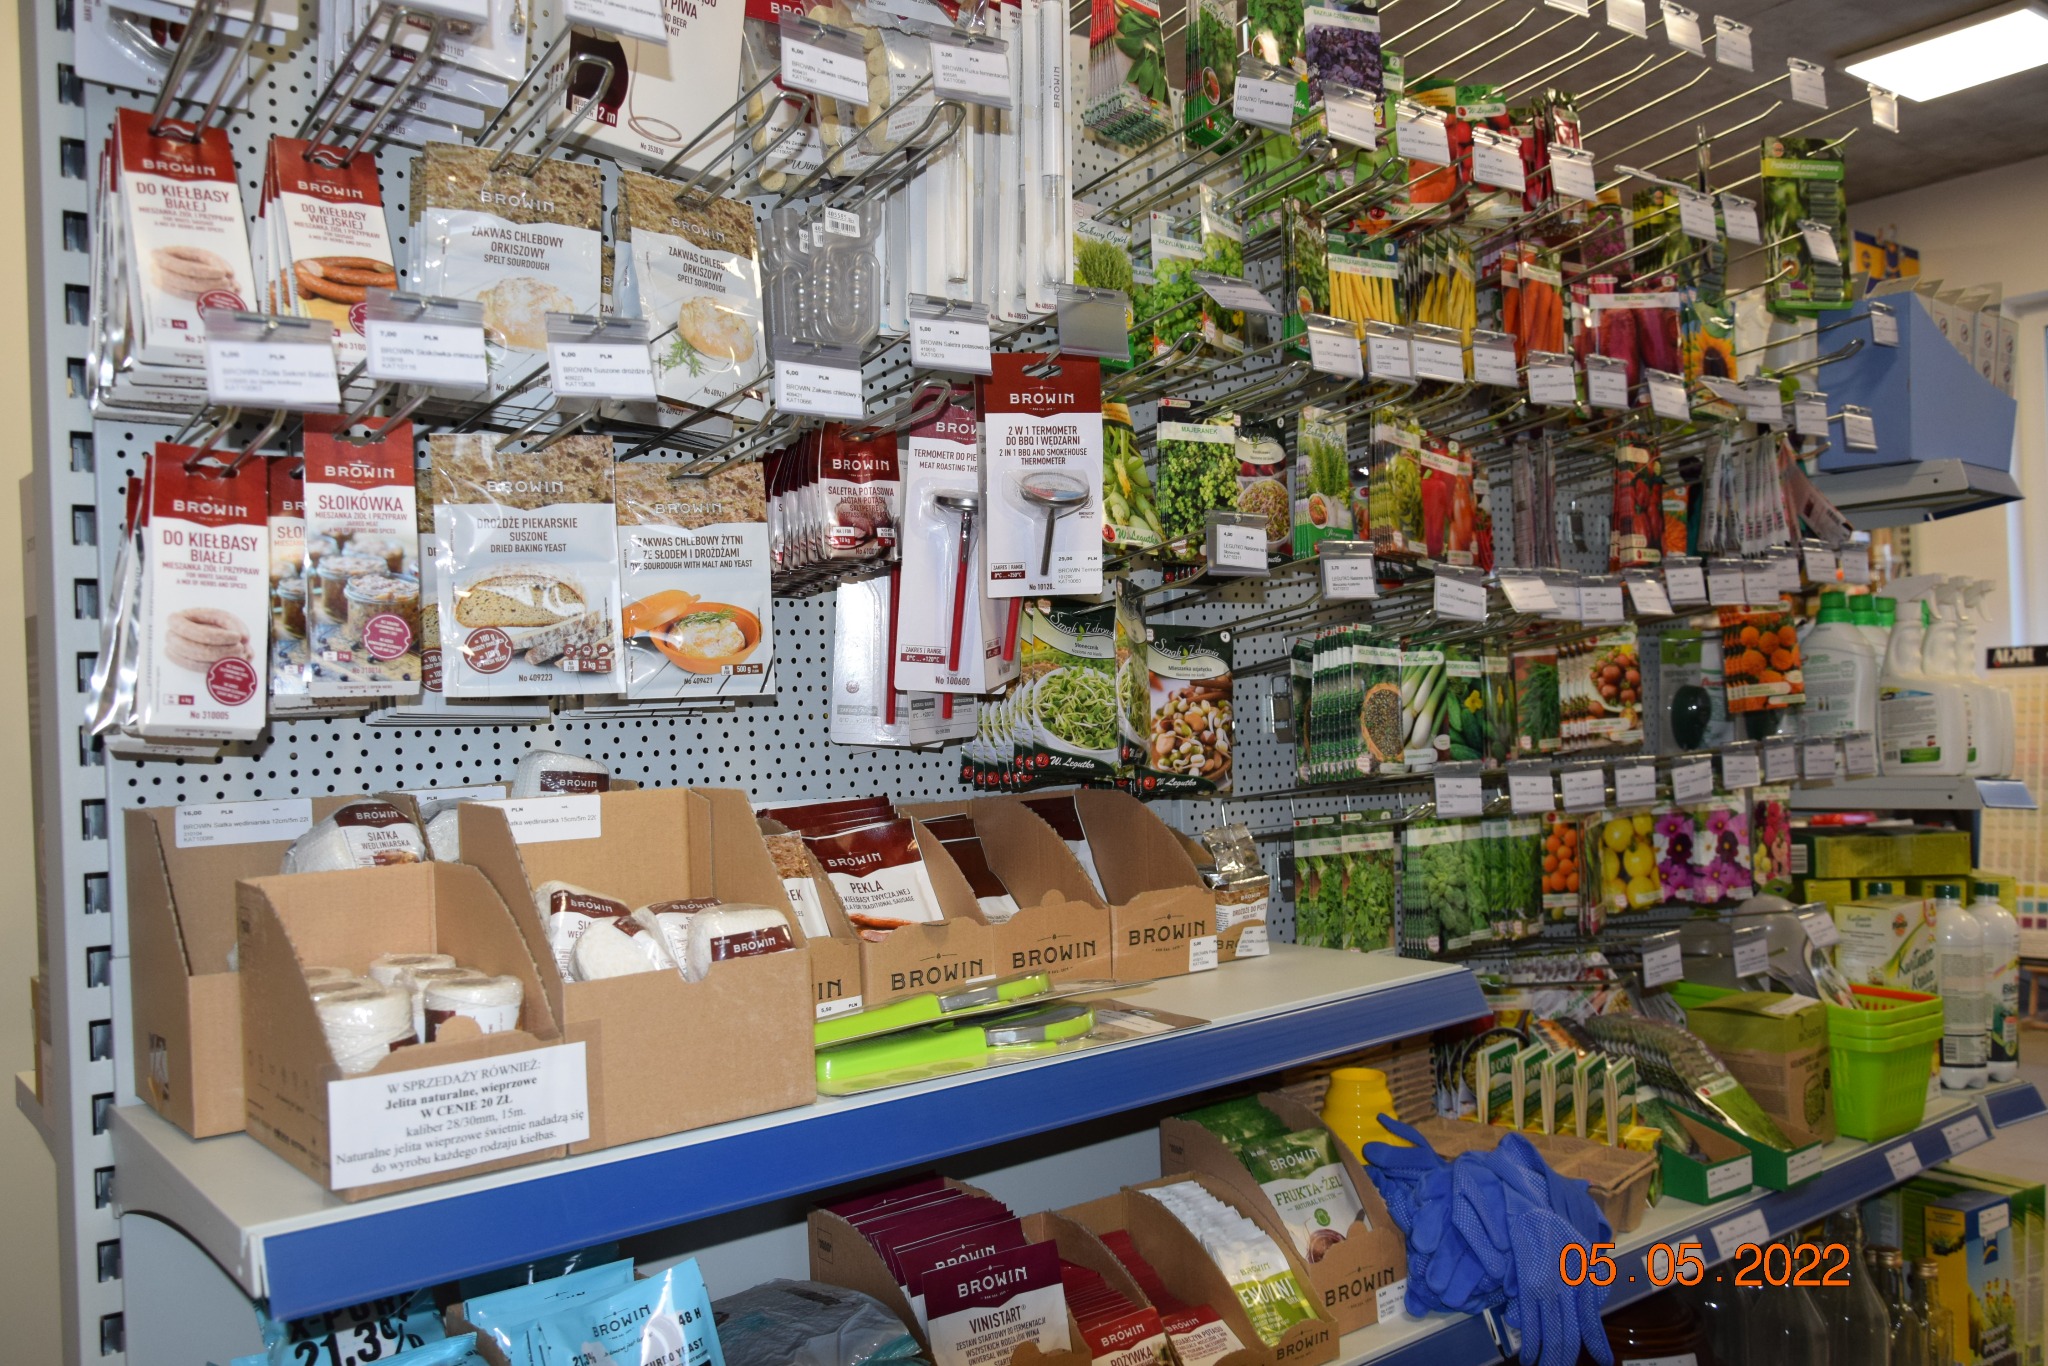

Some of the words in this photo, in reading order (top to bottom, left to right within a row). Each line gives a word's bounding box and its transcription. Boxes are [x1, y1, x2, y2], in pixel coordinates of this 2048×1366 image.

[598, 106, 605, 120] 2
[606, 112, 616, 124] m
[143, 159, 216, 177] BROWIN
[136, 182, 156, 196] DO
[161, 185, 230, 203] KIEŁBASY
[297, 181, 364, 199] BROWIN
[165, 198, 207, 212] BIAŁEJ
[481, 191, 555, 213] BROWIN
[301, 203, 316, 214] DO
[318, 205, 367, 221] KIEŁBASY
[471, 226, 512, 240] ZAKWAS
[514, 231, 564, 248] CHLEBOWY
[671, 217, 726, 244] BROWIN
[490, 242, 545, 260] ORKISZOWY
[483, 254, 505, 265] SPELT
[507, 257, 550, 272] SOURDOUGH
[682, 263, 723, 282] ORKISZOWY
[677, 273, 693, 285] SPELT
[694, 278, 726, 294] SOURDOUGH
[786, 383, 810, 391] BROWIN
[1010, 393, 1075, 404] BROWIN
[1014, 427, 1024, 435] W
[1032, 426, 1078, 435] TERMOMETR
[1181, 426, 1218, 435] MAJERANEK
[1006, 437, 1017, 446] DO
[1018, 437, 1034, 446] BBQ
[1041, 436, 1080, 448] WĘDZARNI
[1004, 449, 1012, 457] IN
[1018, 449, 1031, 457] BBQ
[1047, 448, 1087, 456] SMOKEHOUSE
[1021, 457, 1066, 465] THERMOMETER
[324, 466, 396, 479] BROWIN
[832, 458, 890, 471] BROWIN
[919, 462, 935, 470] MEAT
[936, 462, 966, 472] ROASTING
[487, 481, 565, 493] BROWIN
[828, 486, 858, 496] SALETRA
[858, 487, 895, 497] POTASOWA
[173, 500, 248, 518] BROWIN
[318, 492, 404, 512] SŁOIKÓWKA
[655, 503, 723, 514] BROWIN
[477, 518, 520, 529] DROŻDŻE
[522, 517, 578, 529] PIEKARSKIE
[163, 530, 183, 546] DO
[188, 532, 258, 552] KIEŁBASY
[509, 532, 548, 542] SUSZONE
[637, 537, 673, 548] ZAKWAS
[675, 536, 720, 547] CHLEBOWY
[721, 534, 743, 545] ŻYTNI
[490, 544, 513, 553] DRIED
[515, 543, 543, 553] BAKING
[544, 543, 567, 552] YEAST
[643, 550, 653, 560] ZE
[654, 549, 688, 559] SŁODEM
[694, 548, 740, 558] DROŻDŻAMI
[190, 550, 233, 565] BIAŁEJ
[643, 561, 682, 570] SOURDOUGH
[684, 560, 701, 569] WITH
[702, 560, 718, 568] MALT
[720, 560, 733, 568] AND
[734, 559, 752, 568] YEAST
[905, 646, 924, 654] ZAKRES
[928, 647, 943, 655] RANGE
[1155, 639, 1182, 657] Smak
[529, 674, 553, 682] 409223
[935, 676, 944, 684] No
[946, 677, 970, 686] 100600
[356, 811, 399, 820] BROWIN
[368, 831, 399, 840] SIATKA
[361, 840, 411, 851] WĘDLINIARSKA
[827, 853, 882, 868] BROWIN
[844, 894, 871, 903] KIEŁBASY
[872, 888, 911, 901] ZWYCZAJNEJ
[850, 880, 884, 894] PEKLA
[570, 899, 613, 913] BROWIN
[1128, 920, 1206, 946] BROWIN
[733, 937, 776, 953] BROWIN
[1012, 940, 1097, 969] BROWIN
[891, 959, 984, 991] BROWIN
[387, 1084, 401, 1095] W
[403, 1071, 479, 1093] SPRZEDAŻY
[481, 1058, 541, 1080] RÓWNIEŻ:
[384, 1096, 418, 1111] Jelita
[420, 1088, 479, 1105] naturalne,
[481, 1077, 538, 1098] wieprzowe
[420, 1108, 435, 1119] W
[436, 1101, 478, 1117] CENIE
[480, 1098, 494, 1109] 20
[496, 1094, 513, 1106] ZŁ
[406, 1123, 444, 1138] kaliber
[446, 1113, 499, 1131] 28/30mm,
[501, 1107, 526, 1120] 15m.
[336, 1148, 391, 1165] Naturalne
[394, 1142, 422, 1158] jelita
[425, 1132, 483, 1151] wieprzowe
[484, 1123, 526, 1140] świetnie
[528, 1113, 569, 1130] nadadzą
[570, 1110, 585, 1123] się
[371, 1162, 387, 1175] do
[390, 1156, 431, 1173] wyrobu
[434, 1146, 478, 1163] każdego
[480, 1139, 518, 1156] rodzaju
[520, 1130, 557, 1146] kiełbas.
[1270, 1148, 1321, 1171] BROWIN
[1274, 1176, 1344, 1206] FRUKTA-ŻEL
[1294, 1200, 1318, 1211] NATURAL
[957, 1266, 1028, 1299] BROWIN
[1325, 1268, 1395, 1308] BROWIN
[592, 1304, 652, 1338] BROWIN
[678, 1312, 693, 1326] 48
[694, 1307, 702, 1318] H
[1165, 1317, 1200, 1333] BROWIN
[956, 1339, 976, 1351] ZESTAW
[978, 1330, 1007, 1345] STARTOWY
[1007, 1327, 1014, 1335] DO
[1013, 1317, 1046, 1334] FERMENTACJI
[966, 1342, 1001, 1358] WSZYSTKICH
[1026, 1328, 1040, 1338] WINA
[1100, 1323, 1146, 1348] BROWIN
[1276, 1330, 1330, 1361] BROWIN
